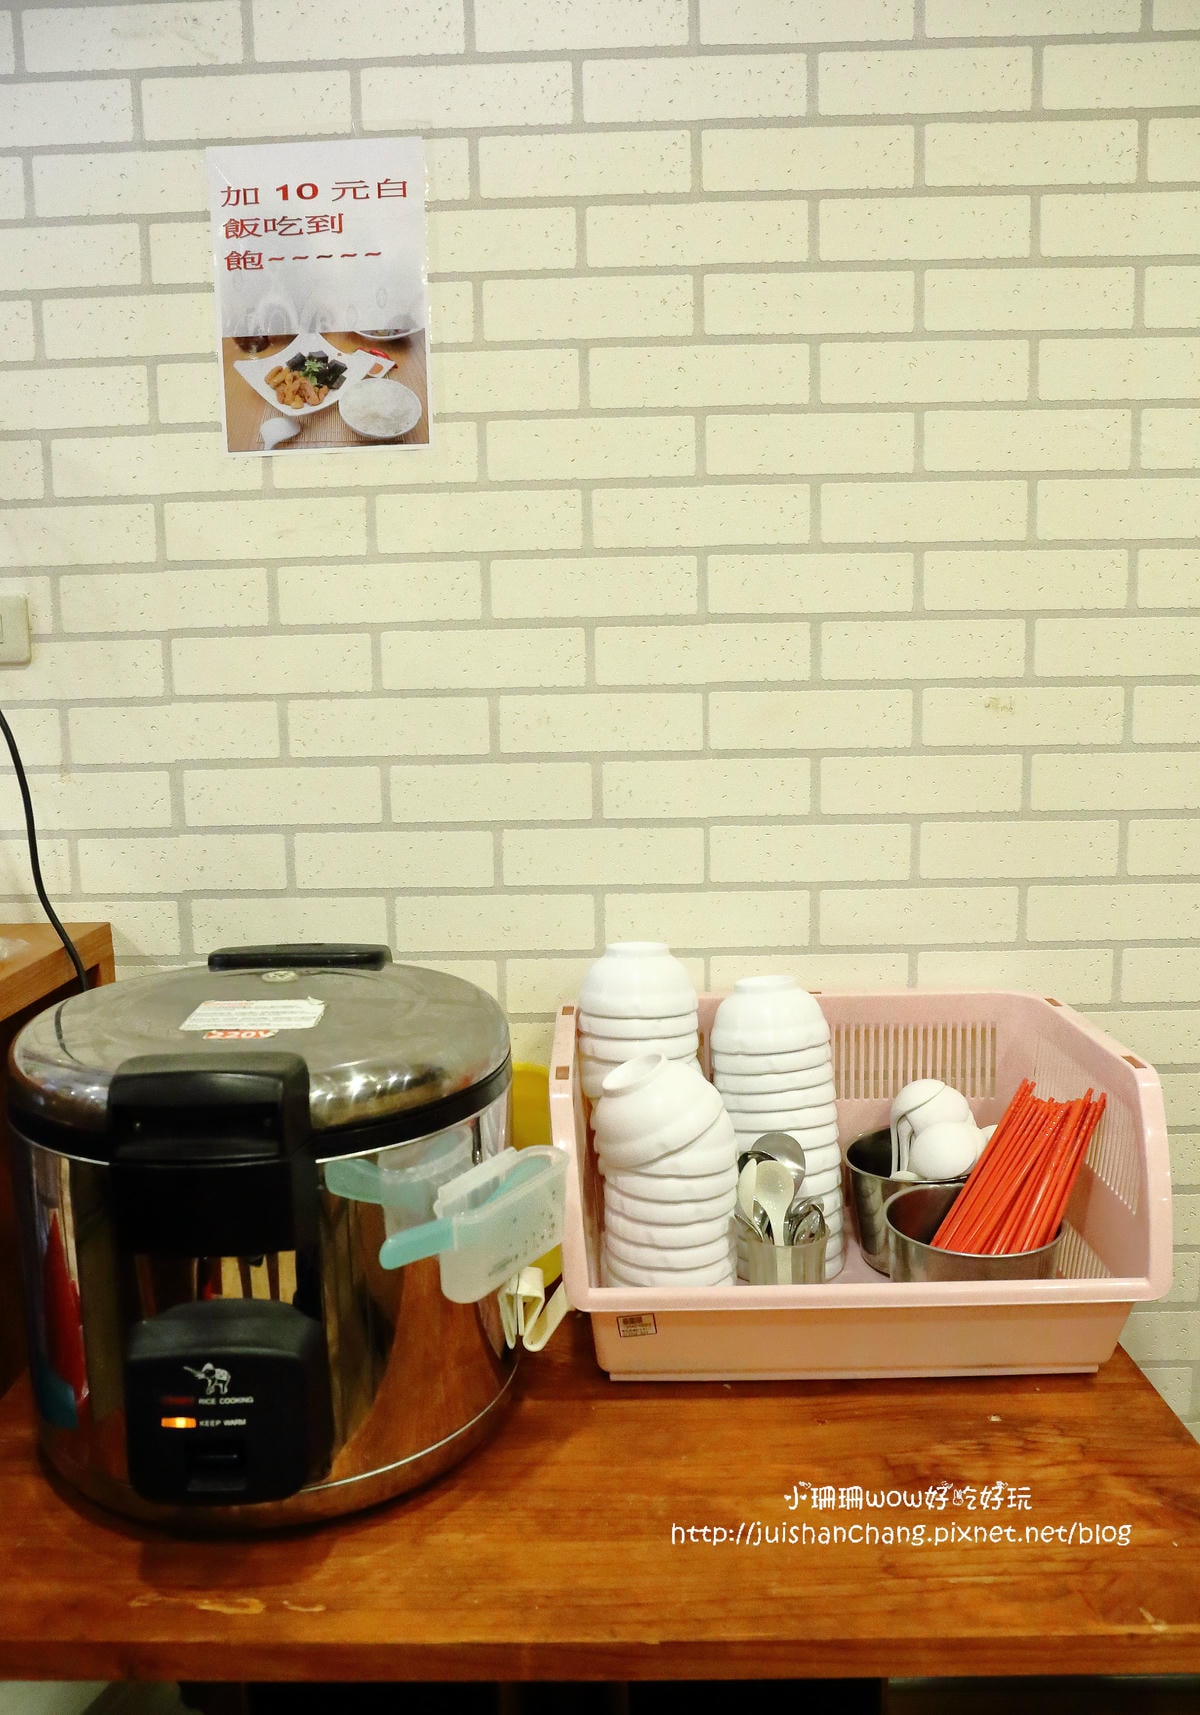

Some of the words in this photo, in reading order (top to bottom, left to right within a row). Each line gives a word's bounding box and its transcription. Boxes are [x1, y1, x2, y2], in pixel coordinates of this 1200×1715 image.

[220, 185, 259, 208] 加
[275, 183, 319, 201] 10
[331, 178, 408, 202] 元白
[222, 212, 344, 239] 飯吃到
[219, 1396, 254, 1405] COOKING
[199, 1419, 221, 1427] KEEP
[223, 1418, 246, 1426] WARM
